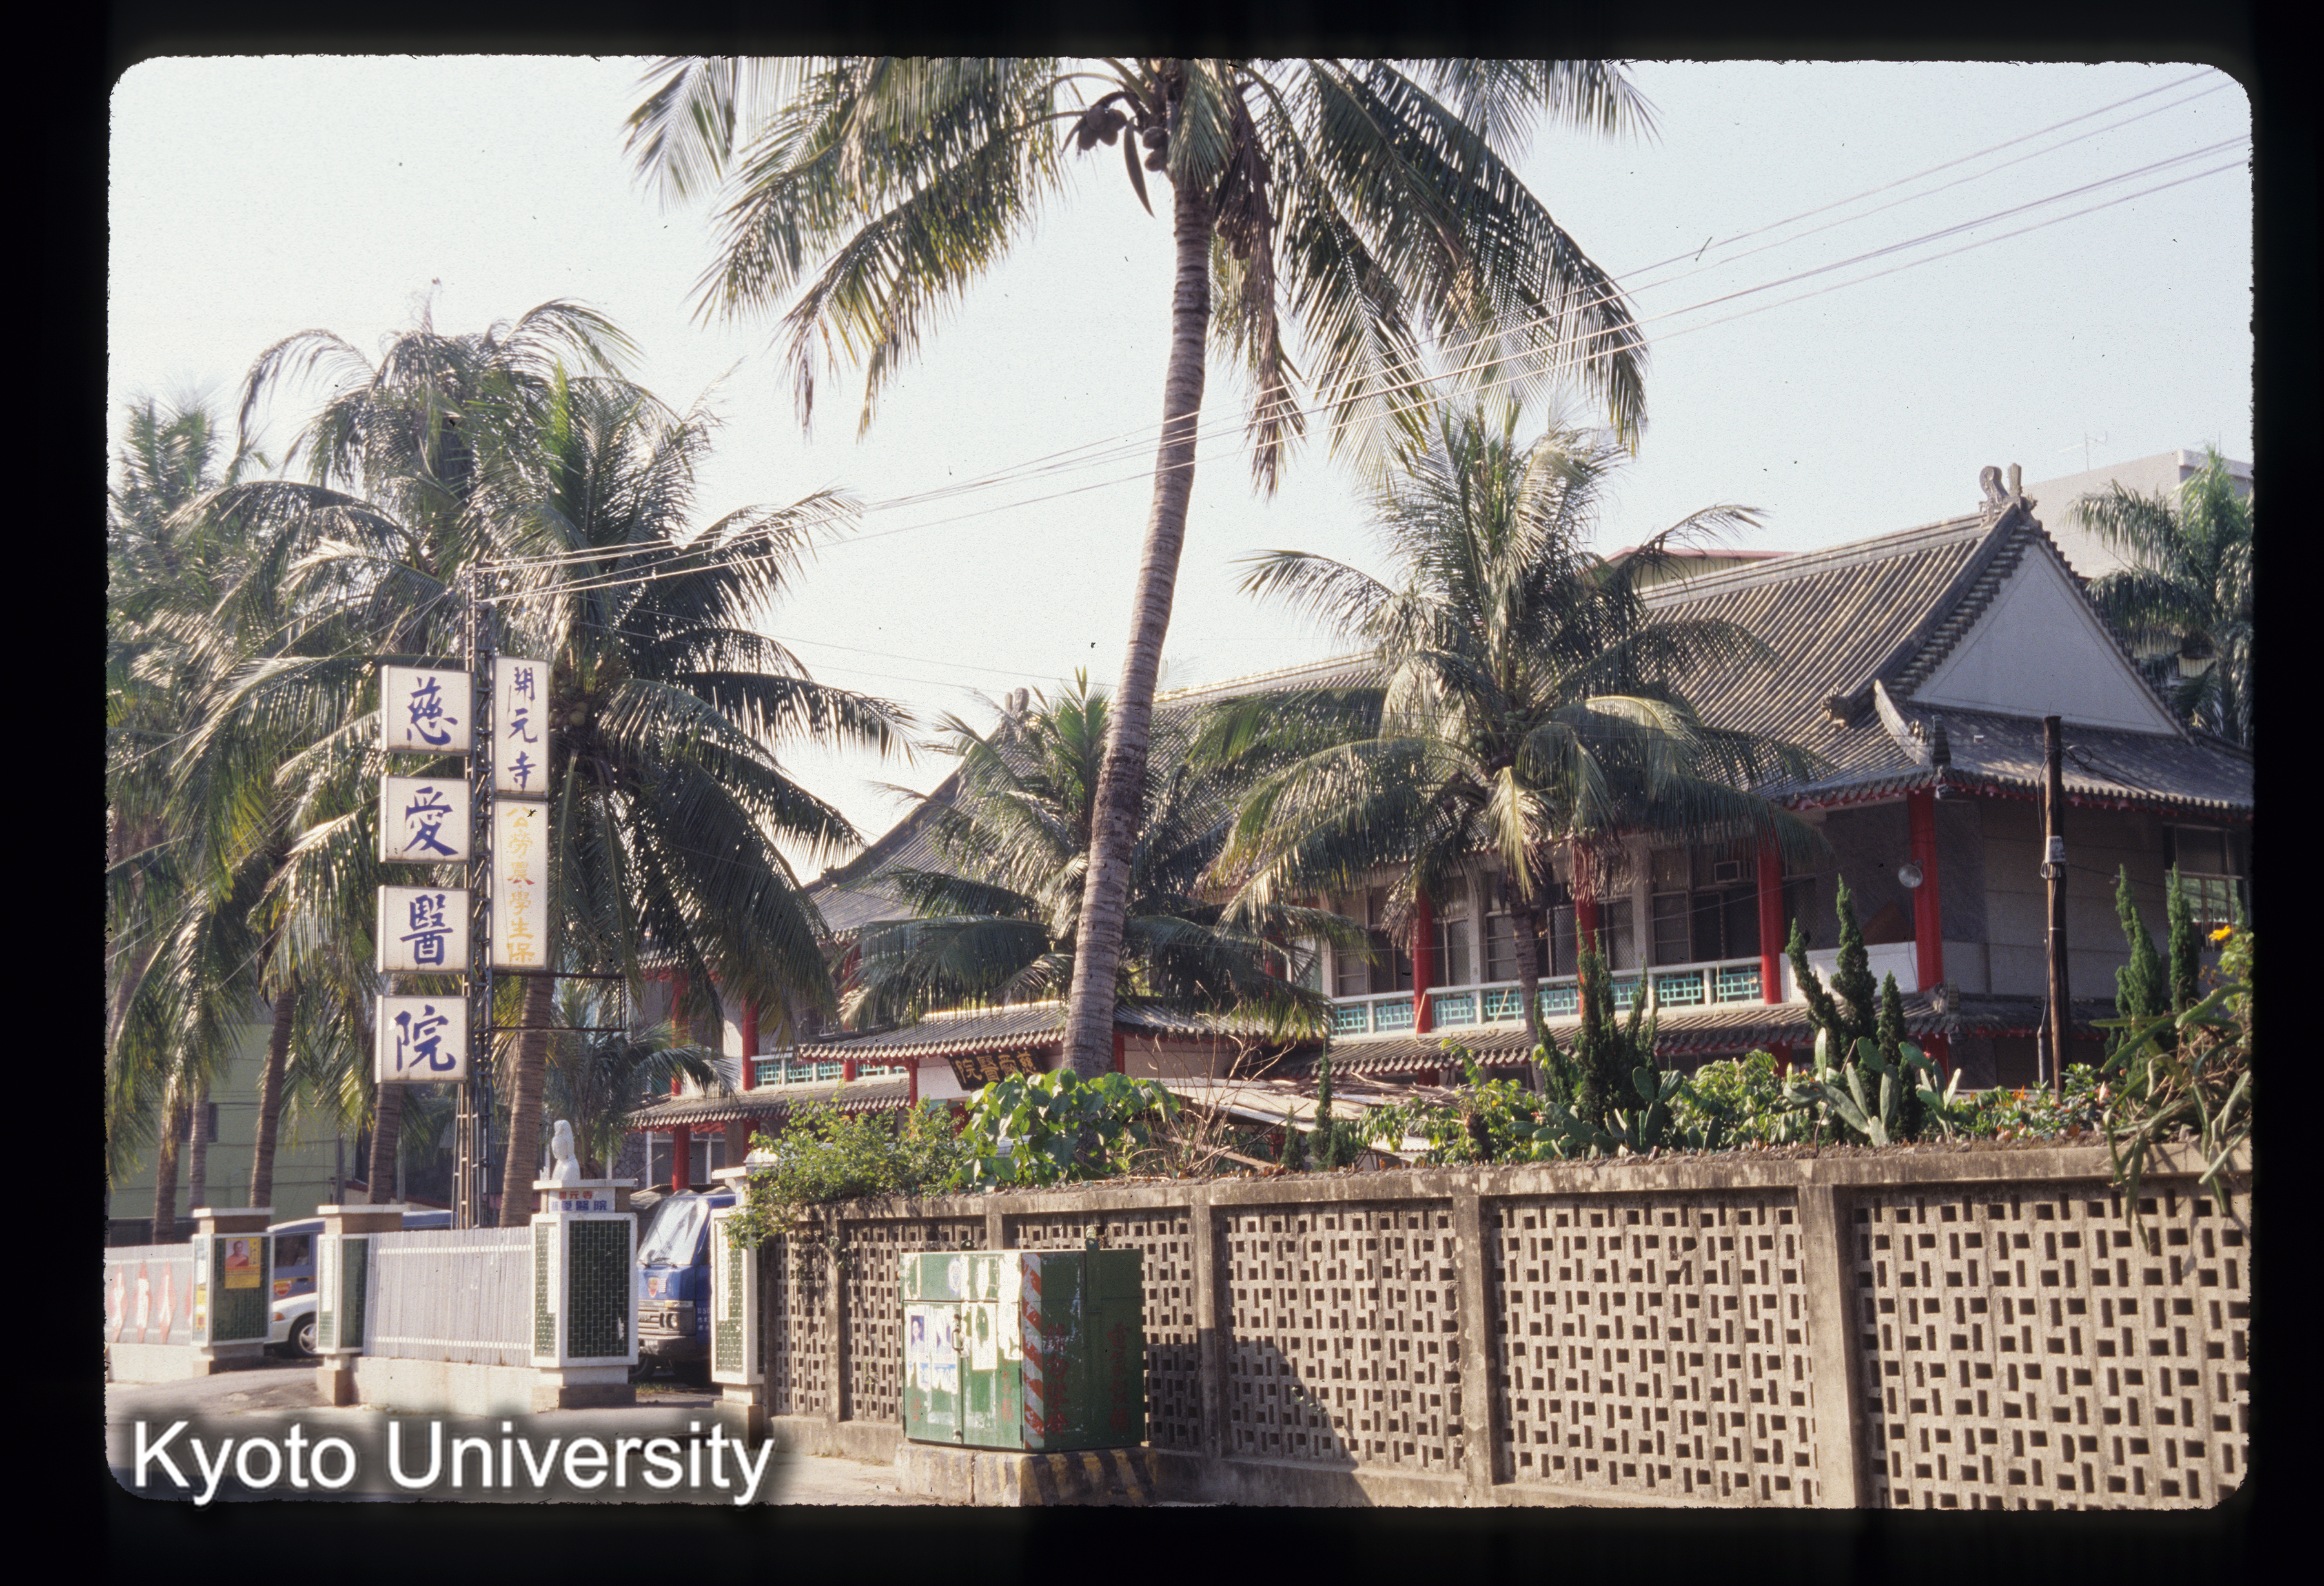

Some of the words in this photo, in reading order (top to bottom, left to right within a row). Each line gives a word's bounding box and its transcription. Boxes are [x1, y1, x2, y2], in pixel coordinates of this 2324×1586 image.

[508, 667, 538, 790] 開元寺
[396, 678, 458, 1071] 慈愛醫院
